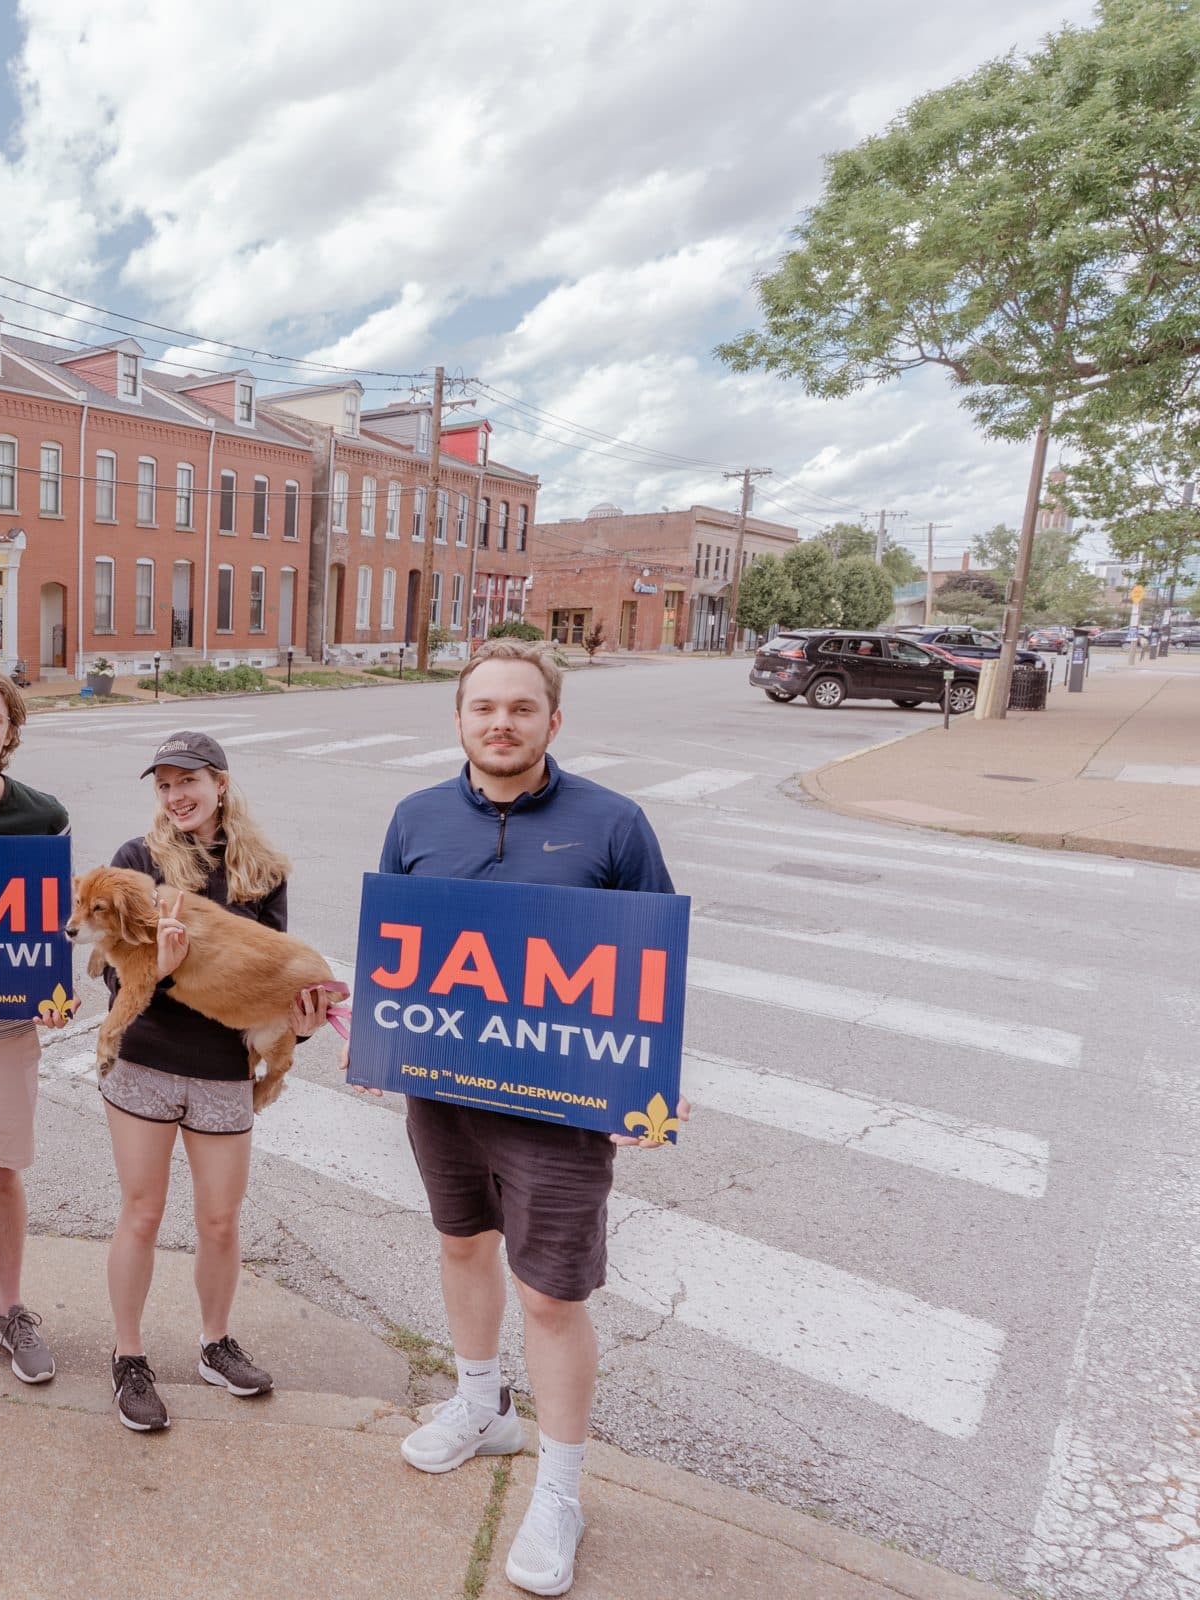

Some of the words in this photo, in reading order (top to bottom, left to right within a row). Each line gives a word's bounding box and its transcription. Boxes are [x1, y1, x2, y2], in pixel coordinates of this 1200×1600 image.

[370, 922, 667, 1023] JAMI
[374, 1000, 465, 1040] COX
[478, 1015, 651, 1068] ANTWI
[401, 1064, 428, 1079] FOR
[429, 1069, 438, 1080] 8
[441, 1069, 452, 1077] TH
[454, 1073, 497, 1089] WARD
[500, 1082, 607, 1110] ALDERWOMAN
